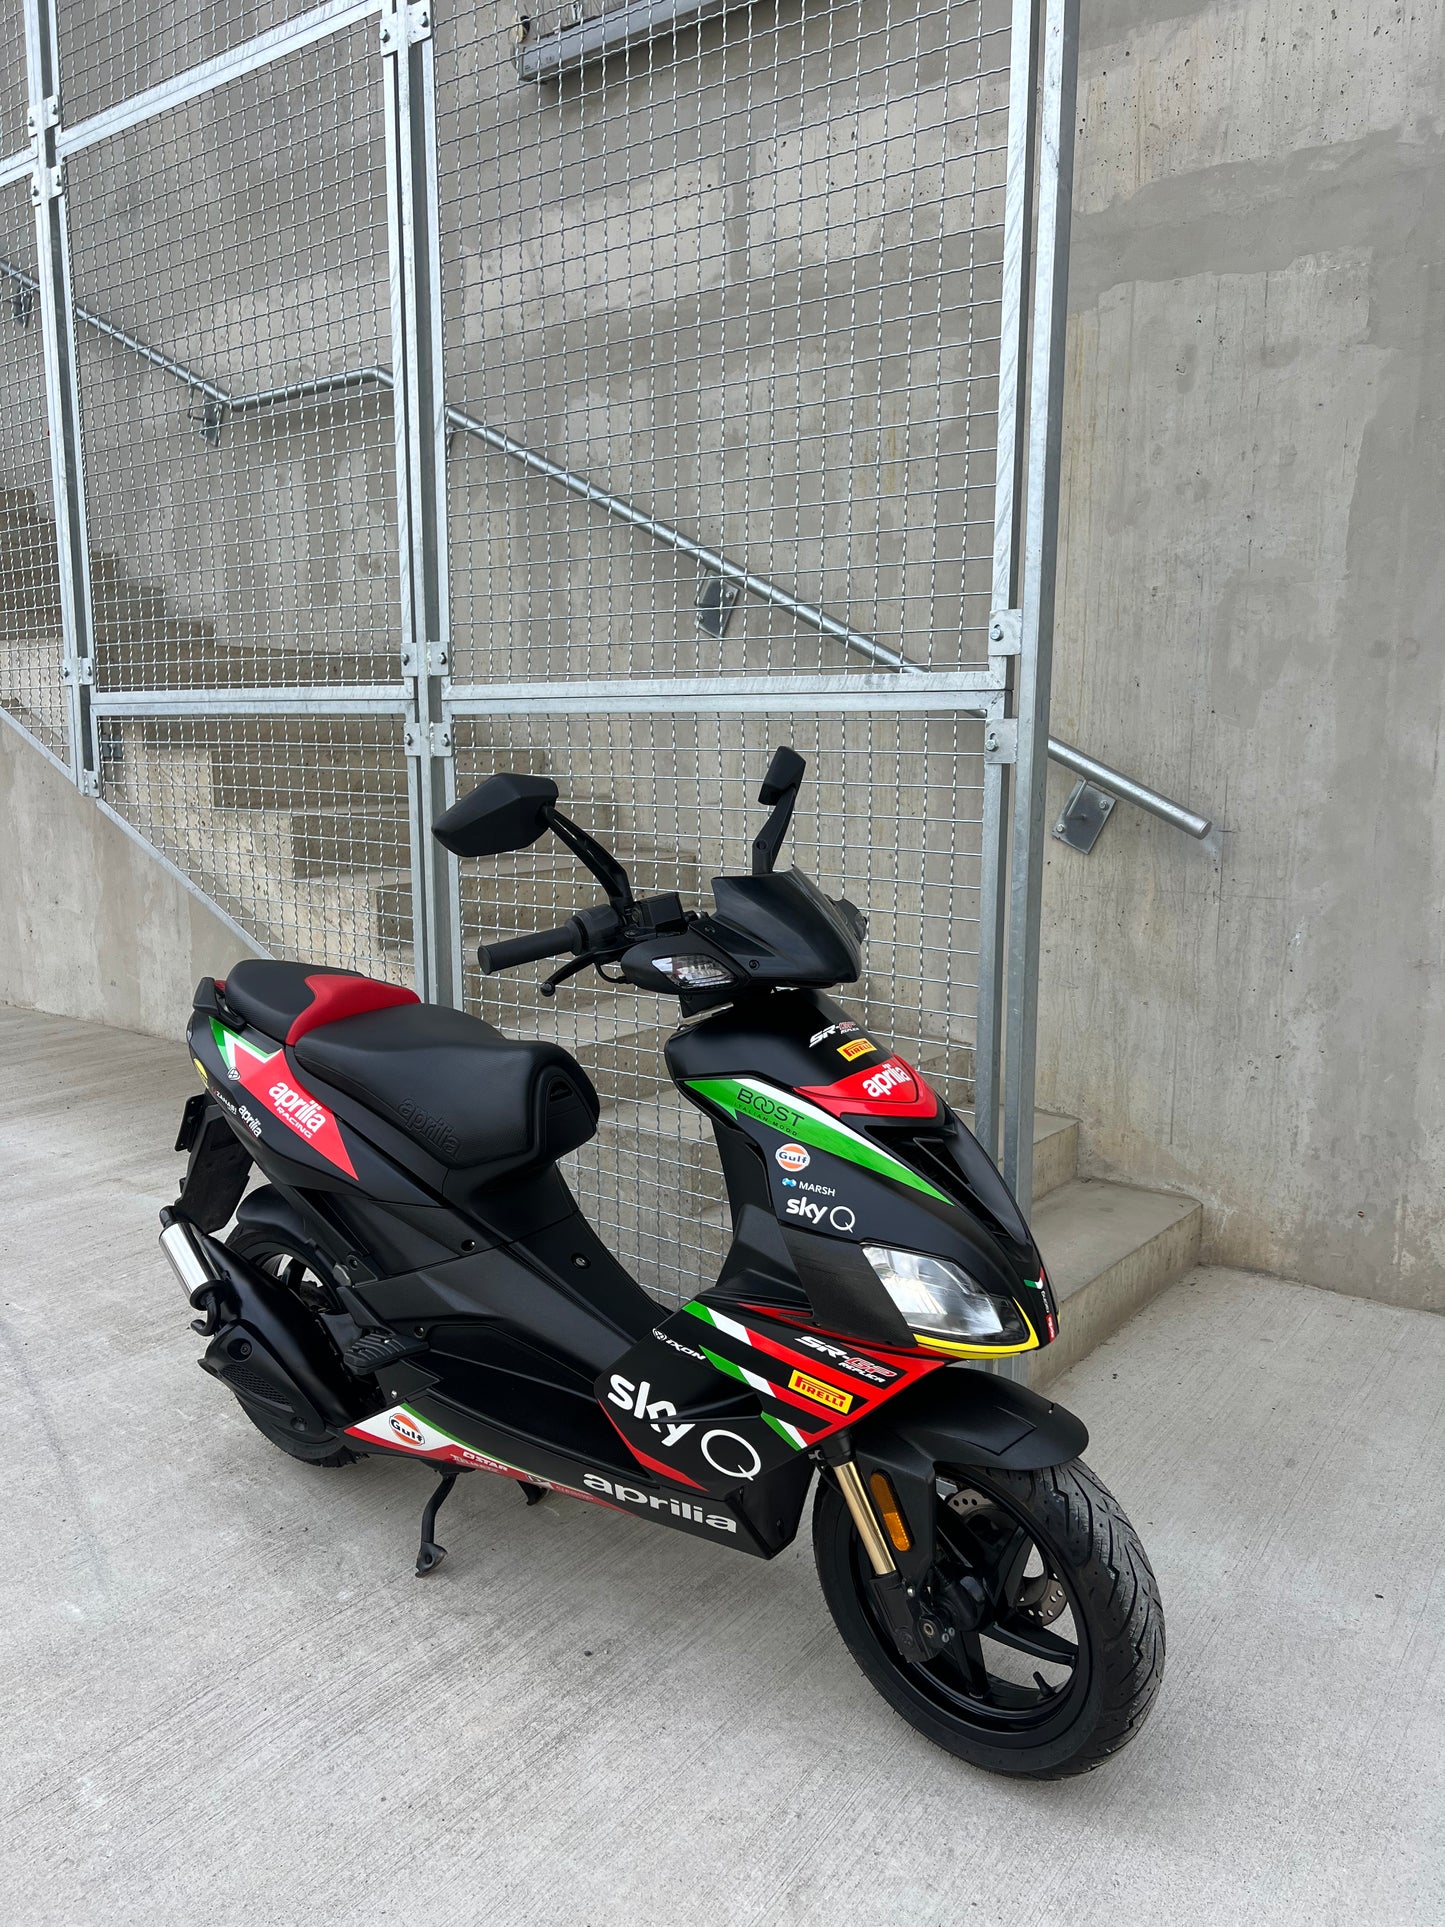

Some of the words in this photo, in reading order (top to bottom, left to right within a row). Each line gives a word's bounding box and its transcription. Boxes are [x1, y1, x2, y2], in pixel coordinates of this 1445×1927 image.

[842, 1040, 873, 1057] PIRELLI
[862, 1063, 912, 1097] aprilia
[238, 1105, 262, 1137] aprilia
[268, 1082, 326, 1133] aprilia
[276, 1106, 313, 1139] RACING
[734, 1102, 768, 1122] ITALIAN
[772, 1121, 798, 1136] MOOD
[737, 1088, 805, 1127] BOOST
[399, 1097, 461, 1160] aprilia
[778, 1151, 807, 1164] Gulf
[799, 1181, 836, 1197] MARSH
[785, 1196, 828, 1225] sky
[829, 1205, 856, 1234] Q
[665, 1339, 707, 1360] IXON
[838, 1362, 886, 1383] REPLICA
[794, 1375, 847, 1408] PIRELLI
[390, 1419, 423, 1442] Gulf
[607, 1374, 696, 1447] sky
[700, 1429, 762, 1481] Q
[583, 1473, 737, 1533] aprilia
